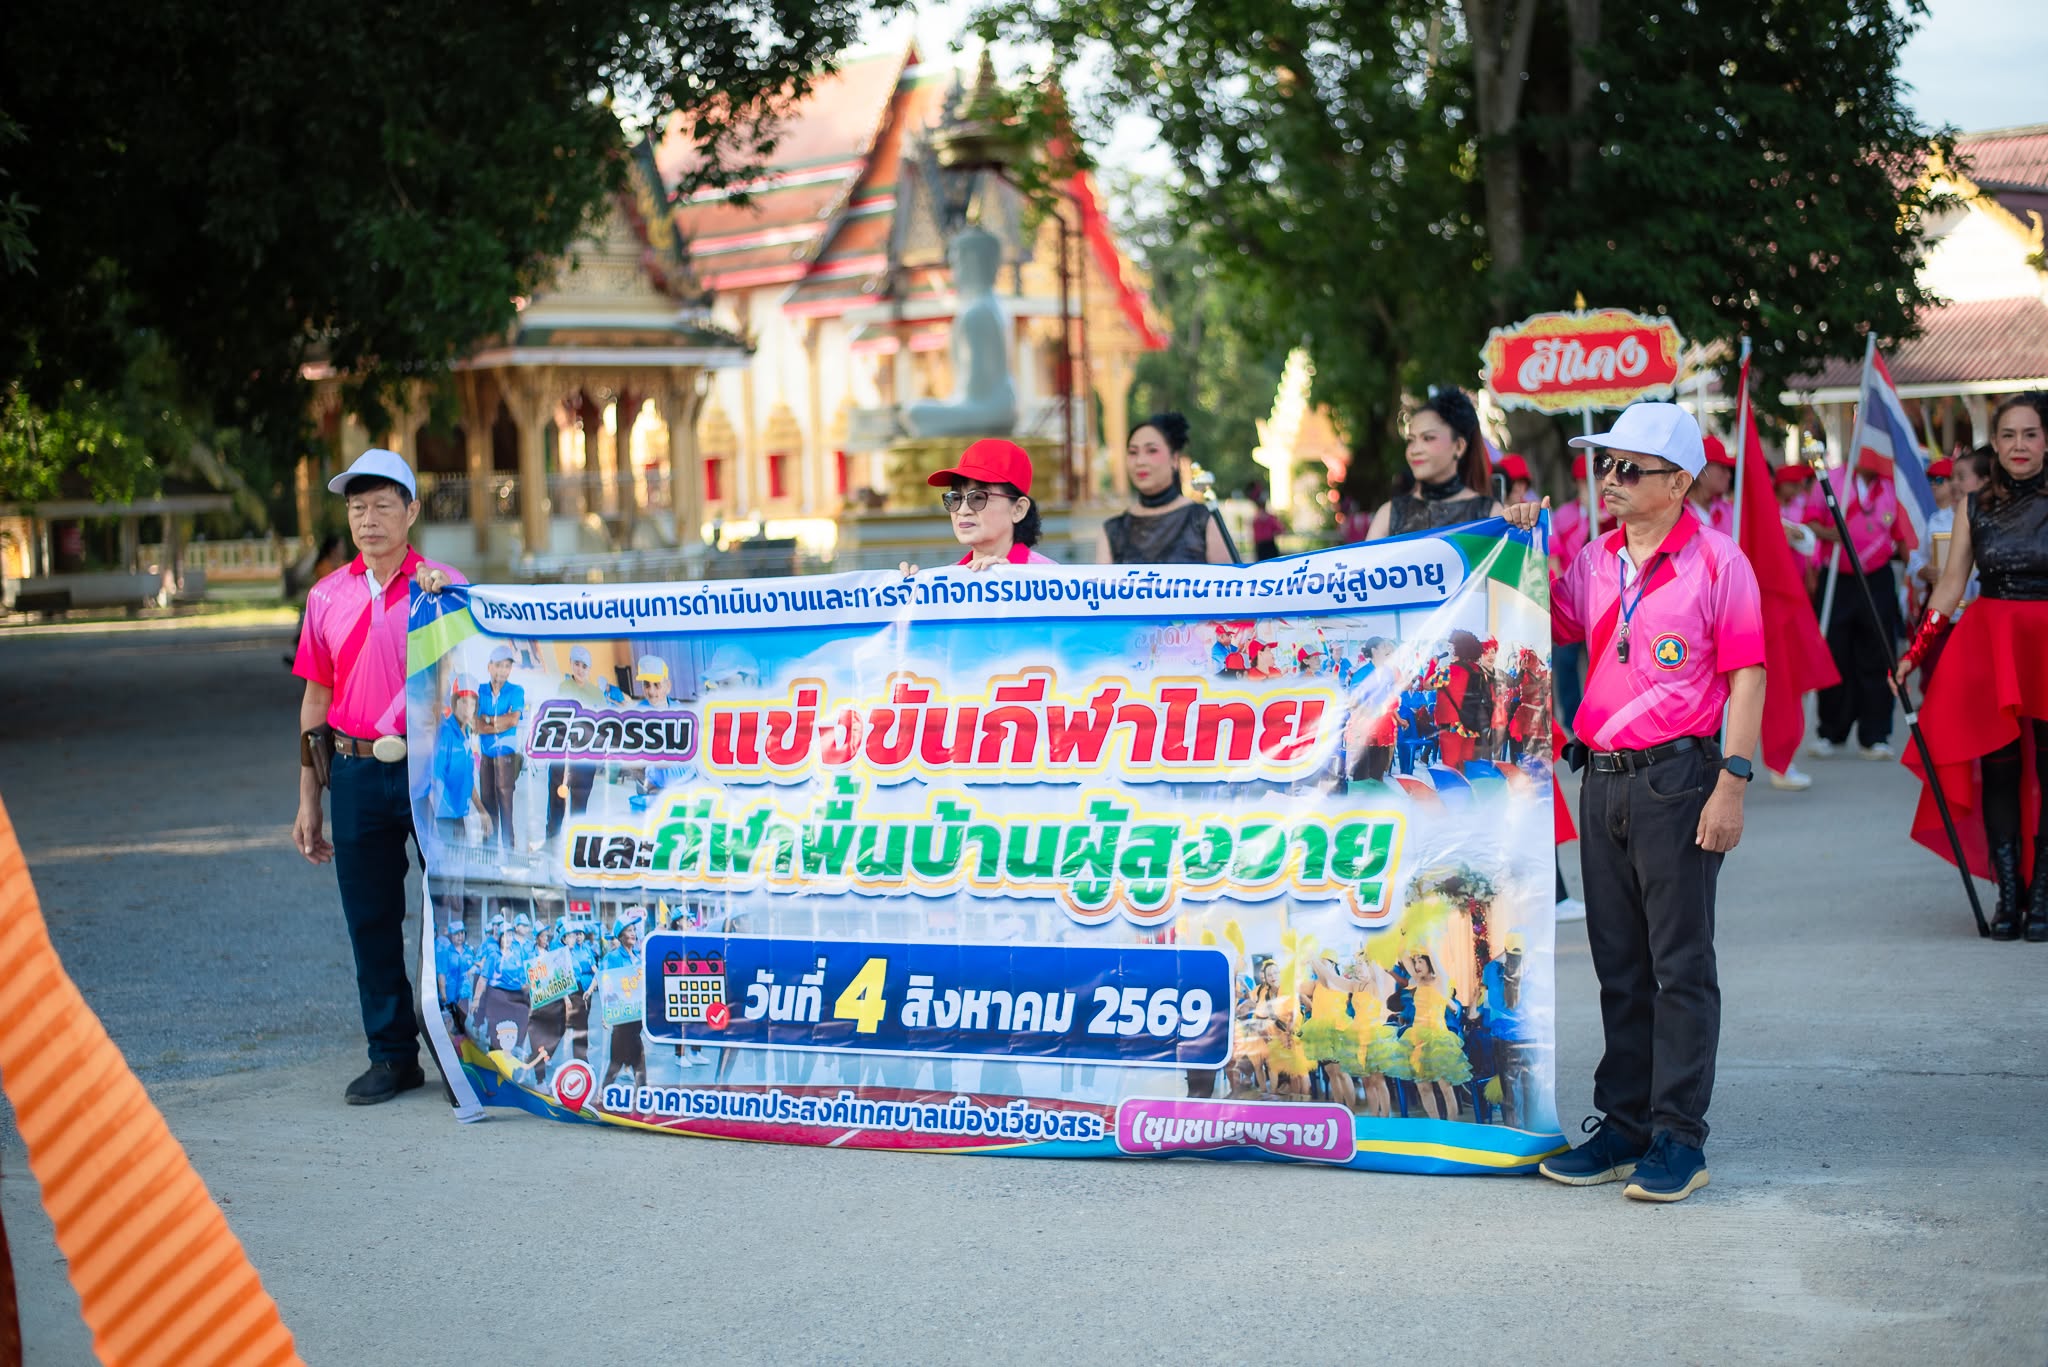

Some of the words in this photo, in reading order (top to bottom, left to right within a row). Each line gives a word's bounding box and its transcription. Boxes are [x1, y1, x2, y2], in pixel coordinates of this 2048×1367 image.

[1518, 335, 1649, 392] สีแดง
[535, 711, 690, 750] กิจกรรม
[712, 678, 1324, 766] แข่งขันกีฬาไทย
[744, 957, 827, 1023] วันที่
[833, 957, 888, 1034] 4
[901, 974, 1077, 1033] สิงหาคม
[1088, 986, 1213, 1038] 2569
[606, 1087, 630, 1108] ณ
[639, 1089, 1101, 1138] อาคารอเนกประสงค์เทศบาลเมืองเวียงสระ
